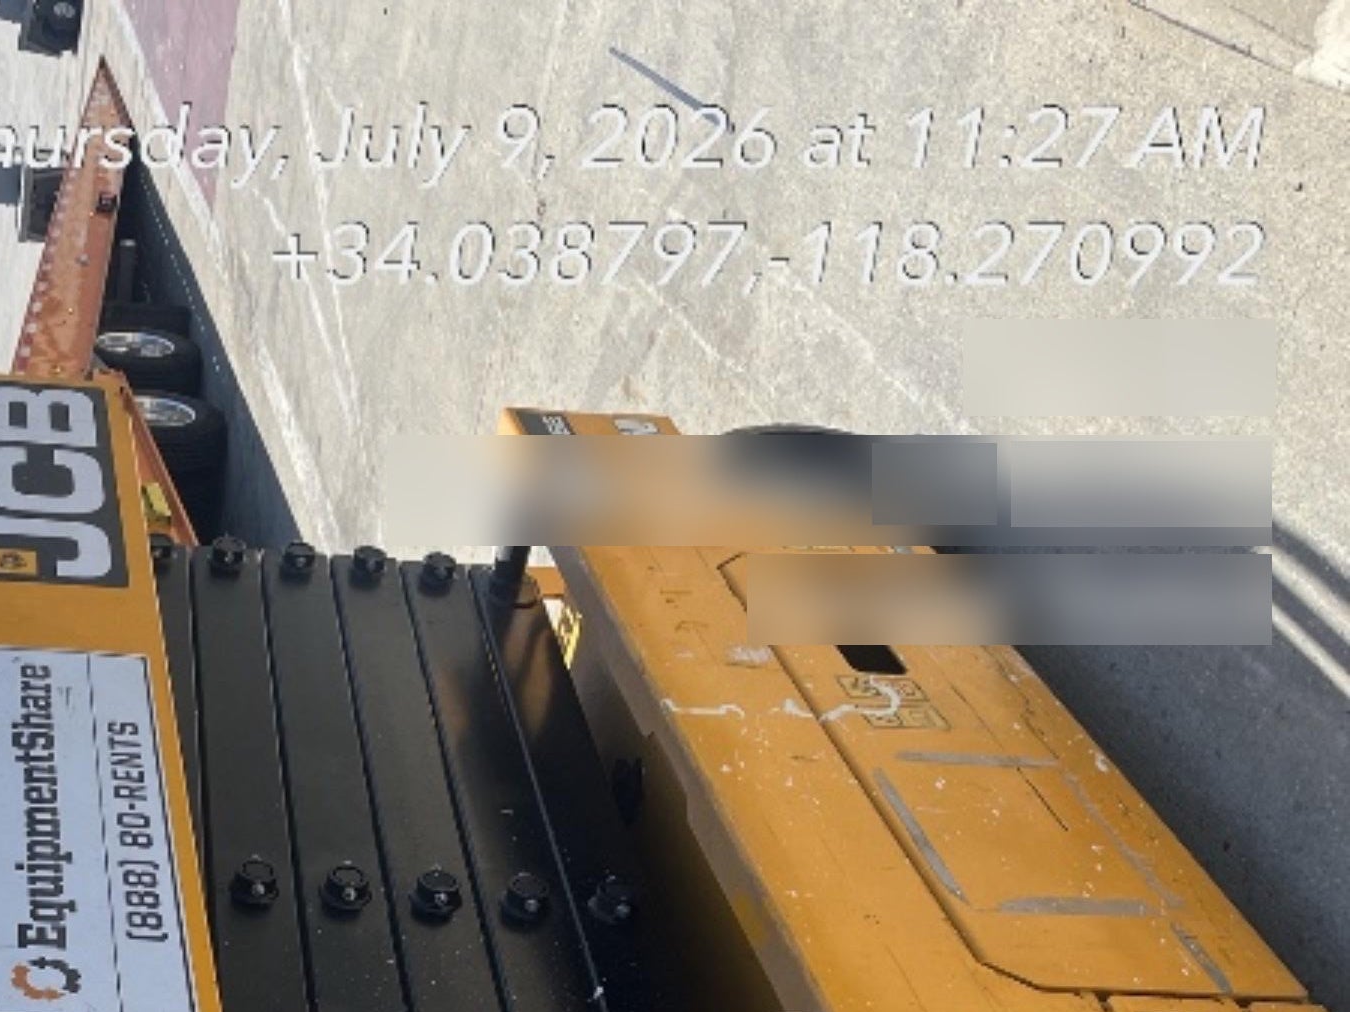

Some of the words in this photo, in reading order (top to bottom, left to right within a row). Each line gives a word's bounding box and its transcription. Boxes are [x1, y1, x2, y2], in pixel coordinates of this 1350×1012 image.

[11, 664, 77, 950] EquipmentShare
[107, 721, 153, 849] 80-RENTS
[117, 860, 168, 943] (888)
